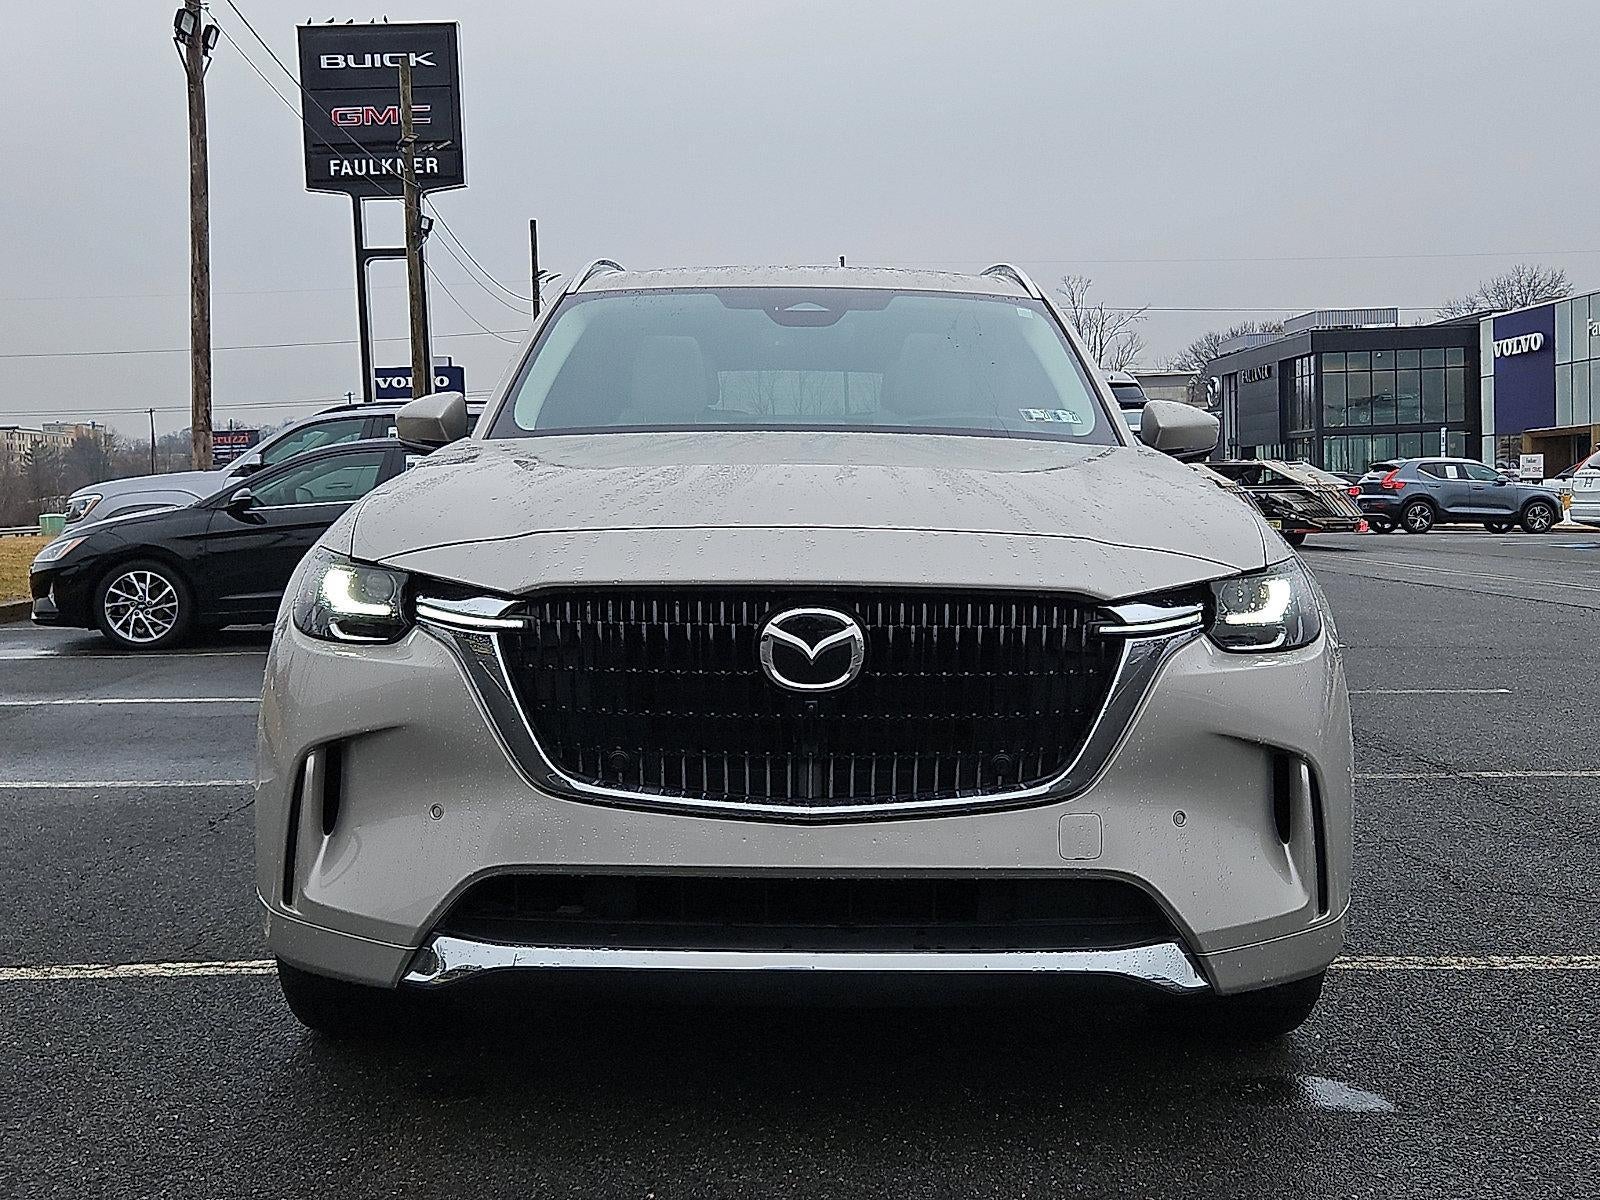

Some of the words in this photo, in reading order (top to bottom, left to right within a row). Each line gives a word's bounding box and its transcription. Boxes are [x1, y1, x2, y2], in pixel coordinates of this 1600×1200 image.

[320, 52, 437, 69] BUICK
[331, 104, 431, 127] GMC
[329, 157, 438, 176] FAULKNER
[1493, 332, 1545, 358] VOLVO
[375, 376, 450, 389] VOLO
